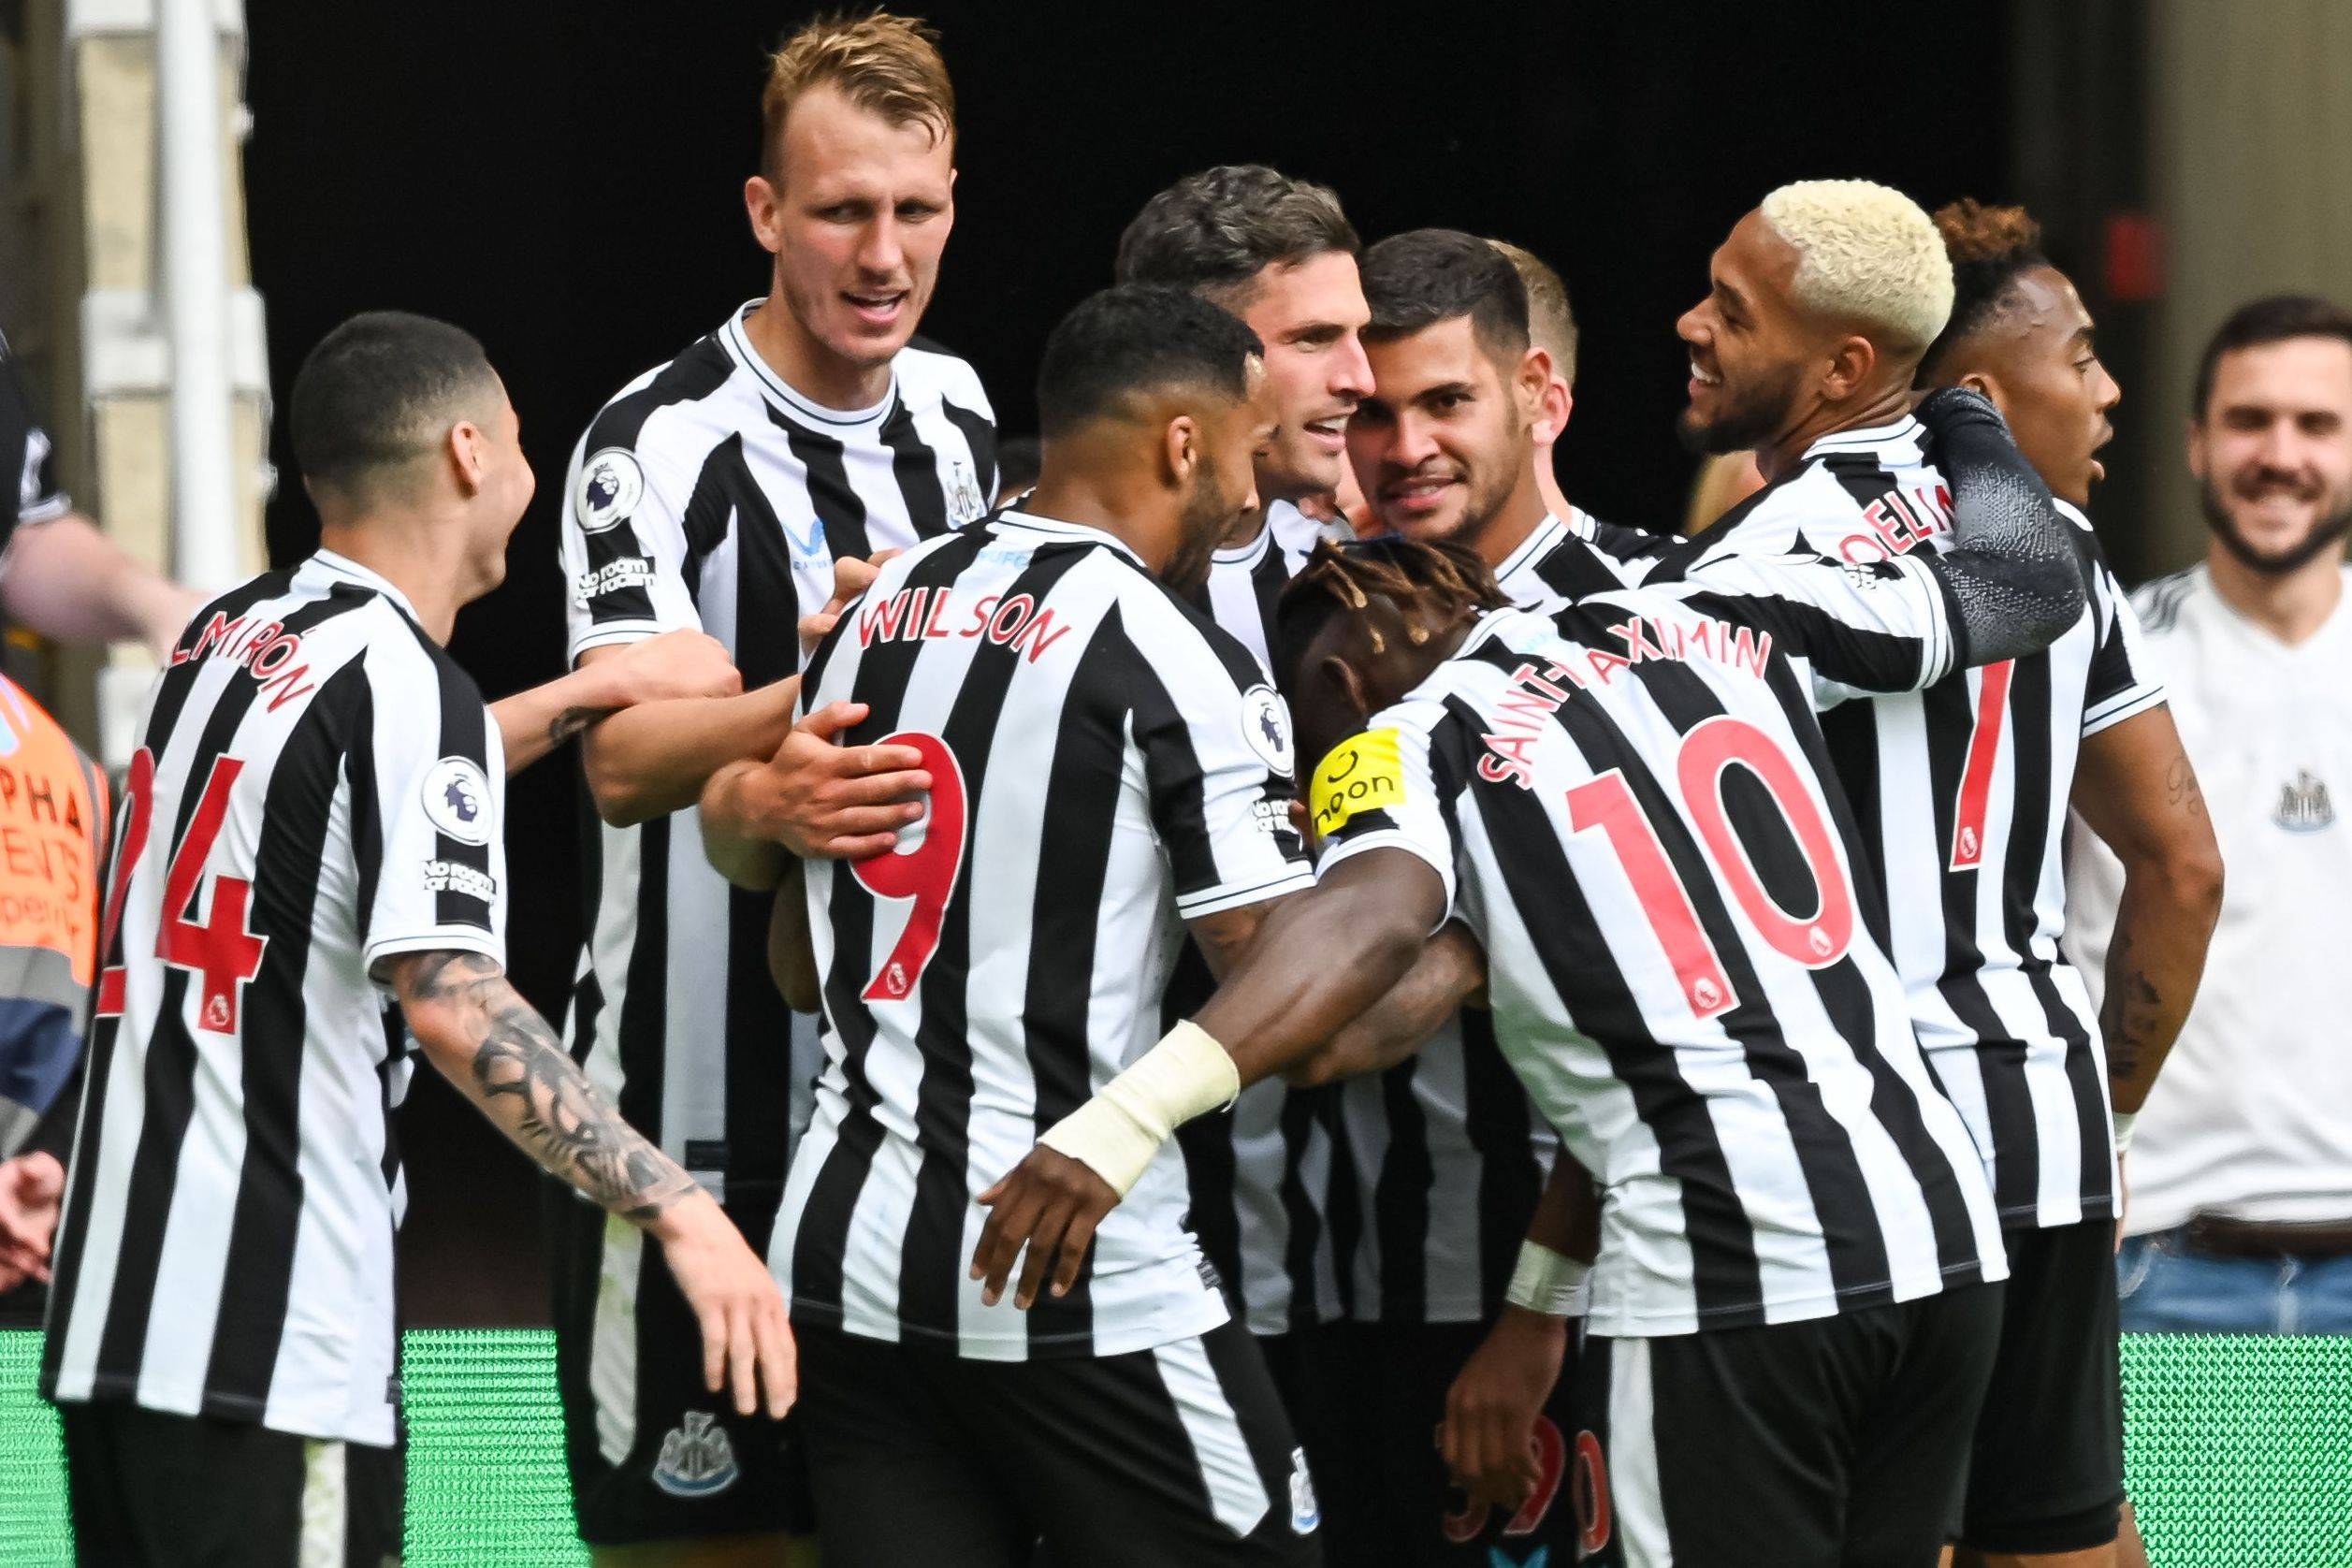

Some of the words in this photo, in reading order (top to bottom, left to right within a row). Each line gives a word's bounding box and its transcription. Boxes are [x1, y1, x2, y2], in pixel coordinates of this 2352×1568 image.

[1838, 485, 1956, 564] OELIN
[171, 610, 317, 714] LMIRÓN
[860, 587, 1071, 663] WILSON
[1314, 776, 1395, 835] noon
[848, 732, 968, 1002] 9
[1564, 713, 1854, 1020] 10
